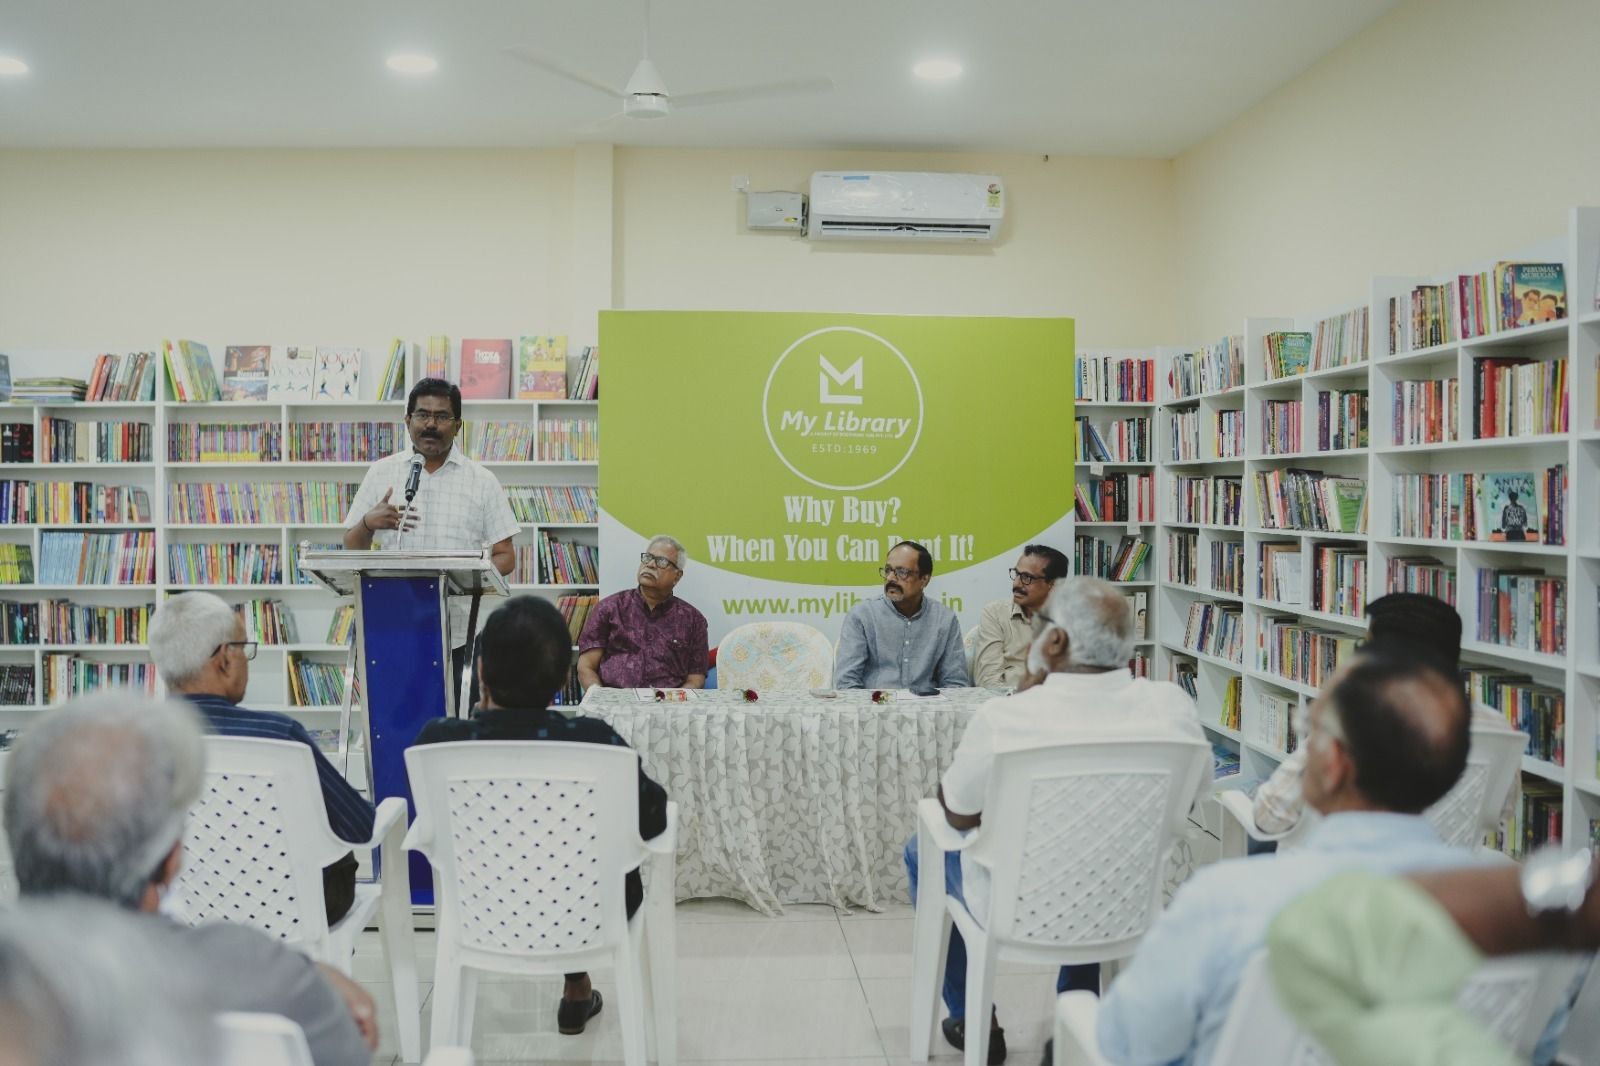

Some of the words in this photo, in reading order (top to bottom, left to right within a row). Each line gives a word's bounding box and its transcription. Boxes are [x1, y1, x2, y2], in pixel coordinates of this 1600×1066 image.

[320, 353, 359, 364] YOGA
[780, 410, 818, 437] My
[824, 410, 912, 439] Library
[783, 495, 835, 527] Why
[842, 495, 901, 528] Buy?
[706, 535, 776, 563] When
[783, 534, 829, 562] You
[836, 534, 880, 562] Can
[949, 534, 975, 561] It!
